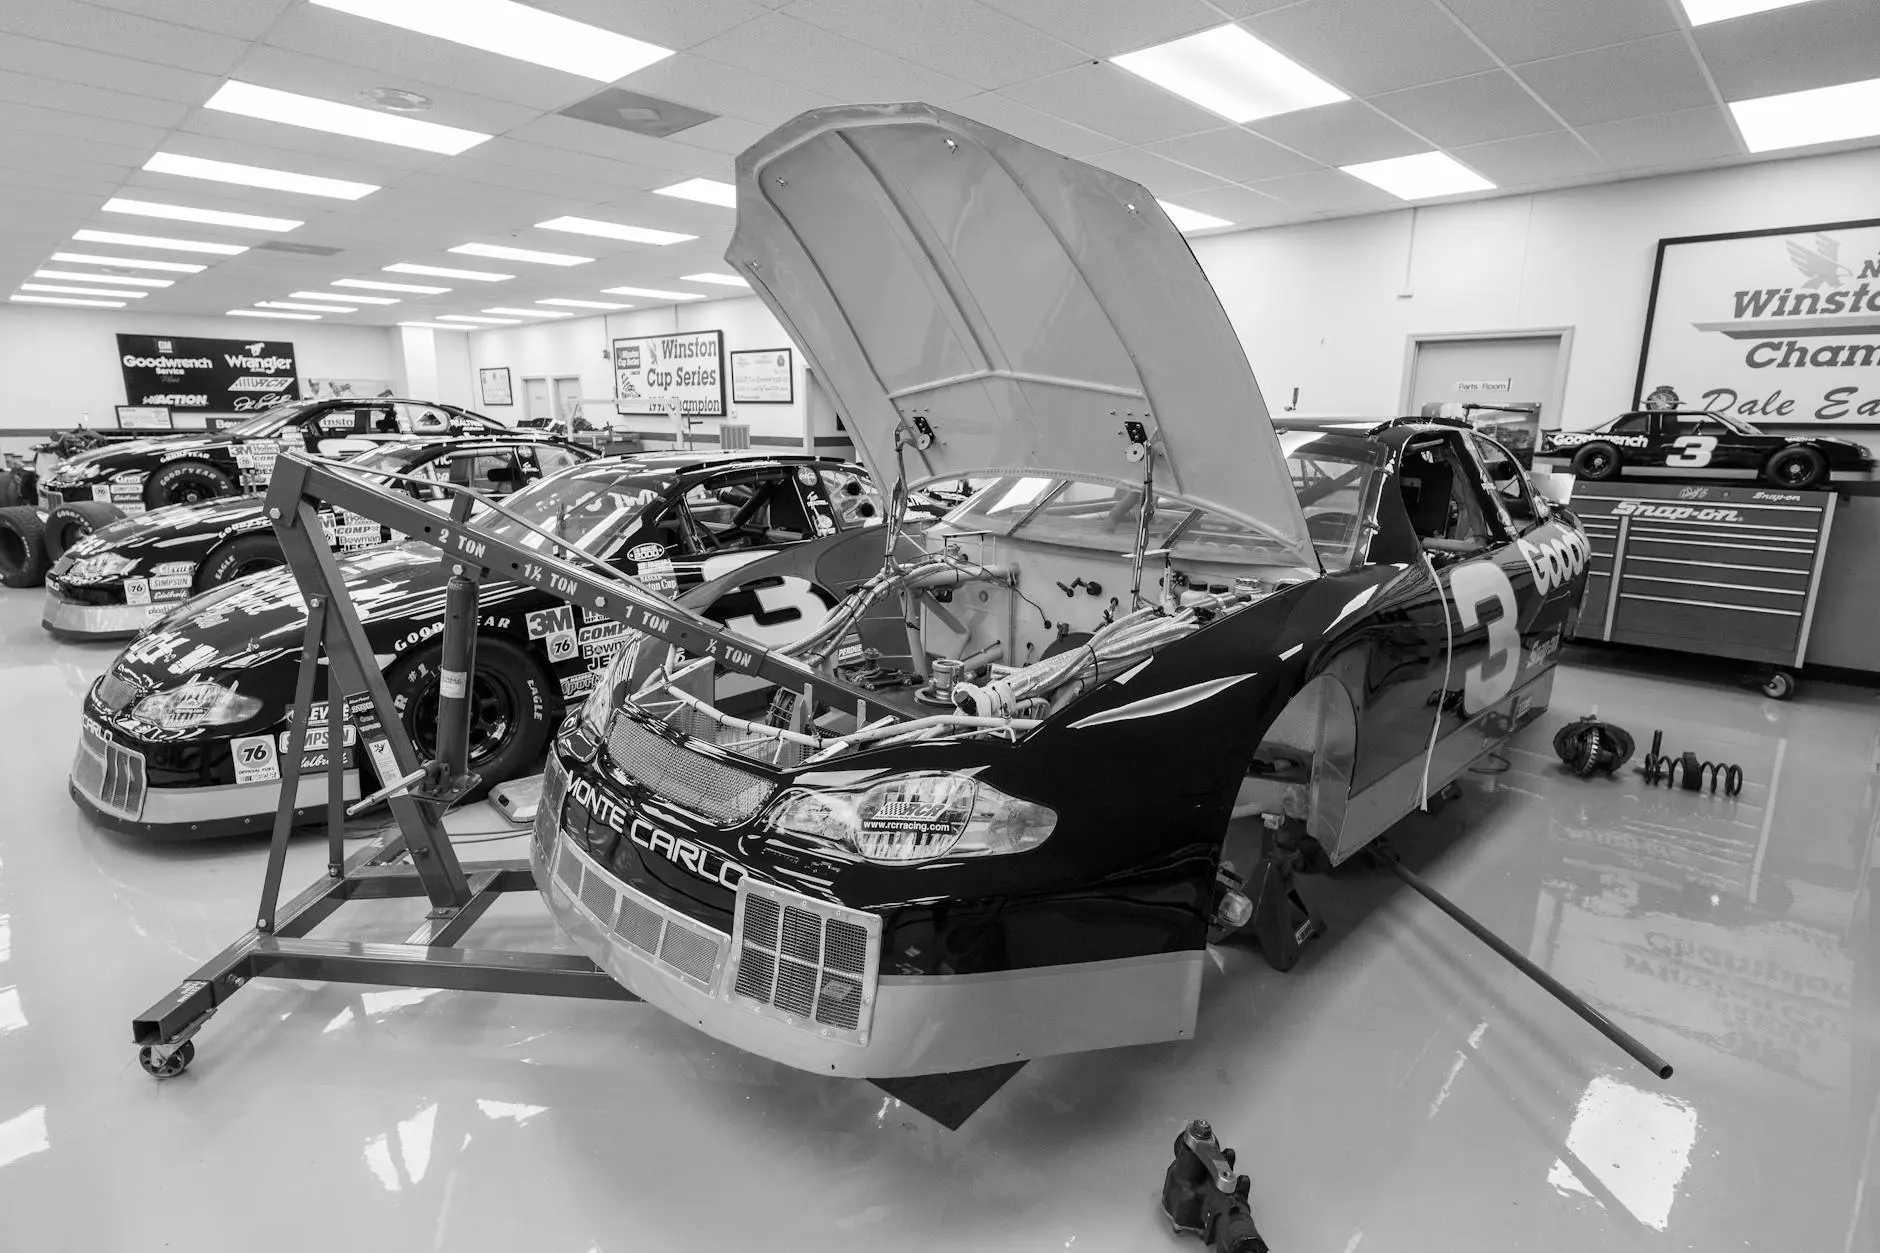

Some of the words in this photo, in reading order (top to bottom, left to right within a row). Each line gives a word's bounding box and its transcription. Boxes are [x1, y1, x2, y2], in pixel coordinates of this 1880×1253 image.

[661, 336, 718, 360] Winston
[123, 354, 213, 369] Goodwrench
[155, 367, 185, 376] Service
[224, 353, 293, 375] Wrangler
[647, 367, 673, 391] Cup
[676, 365, 717, 386] Series
[1458, 382, 1479, 391] Parts
[1481, 382, 1507, 391] Room
[1702, 387, 1795, 417] Dale
[1665, 435, 1719, 468] 3
[159, 466, 217, 486] GOODYEAR
[1752, 491, 1801, 502] Snap-on
[1611, 501, 1744, 522] Snap-on
[336, 526, 372, 536] COMP
[340, 535, 382, 544] Bowman
[437, 529, 449, 545] 2
[457, 535, 487, 559] TON
[214, 554, 236, 580] EAGLE
[131, 584, 144, 593] 76
[154, 579, 189, 587] SIMPSON
[550, 572, 578, 596] TON
[661, 579, 677, 590] Cup
[625, 604, 634, 619] 1
[642, 611, 669, 634] TON
[724, 574, 828, 648] 3
[529, 606, 574, 638] 3M
[394, 615, 512, 652] GOODEAR
[1450, 561, 1521, 716] 3
[553, 639, 571, 655] 76
[724, 645, 752, 668] TON
[838, 643, 863, 656] PERDUE
[408, 662, 429, 683] #1
[526, 679, 543, 721] EAGLE
[243, 744, 268, 762] 76
[567, 769, 627, 834] MONTE
[902, 803, 946, 817] RCR
[862, 820, 951, 832] www.rcrracing.com
[630, 818, 749, 892] CARLO
